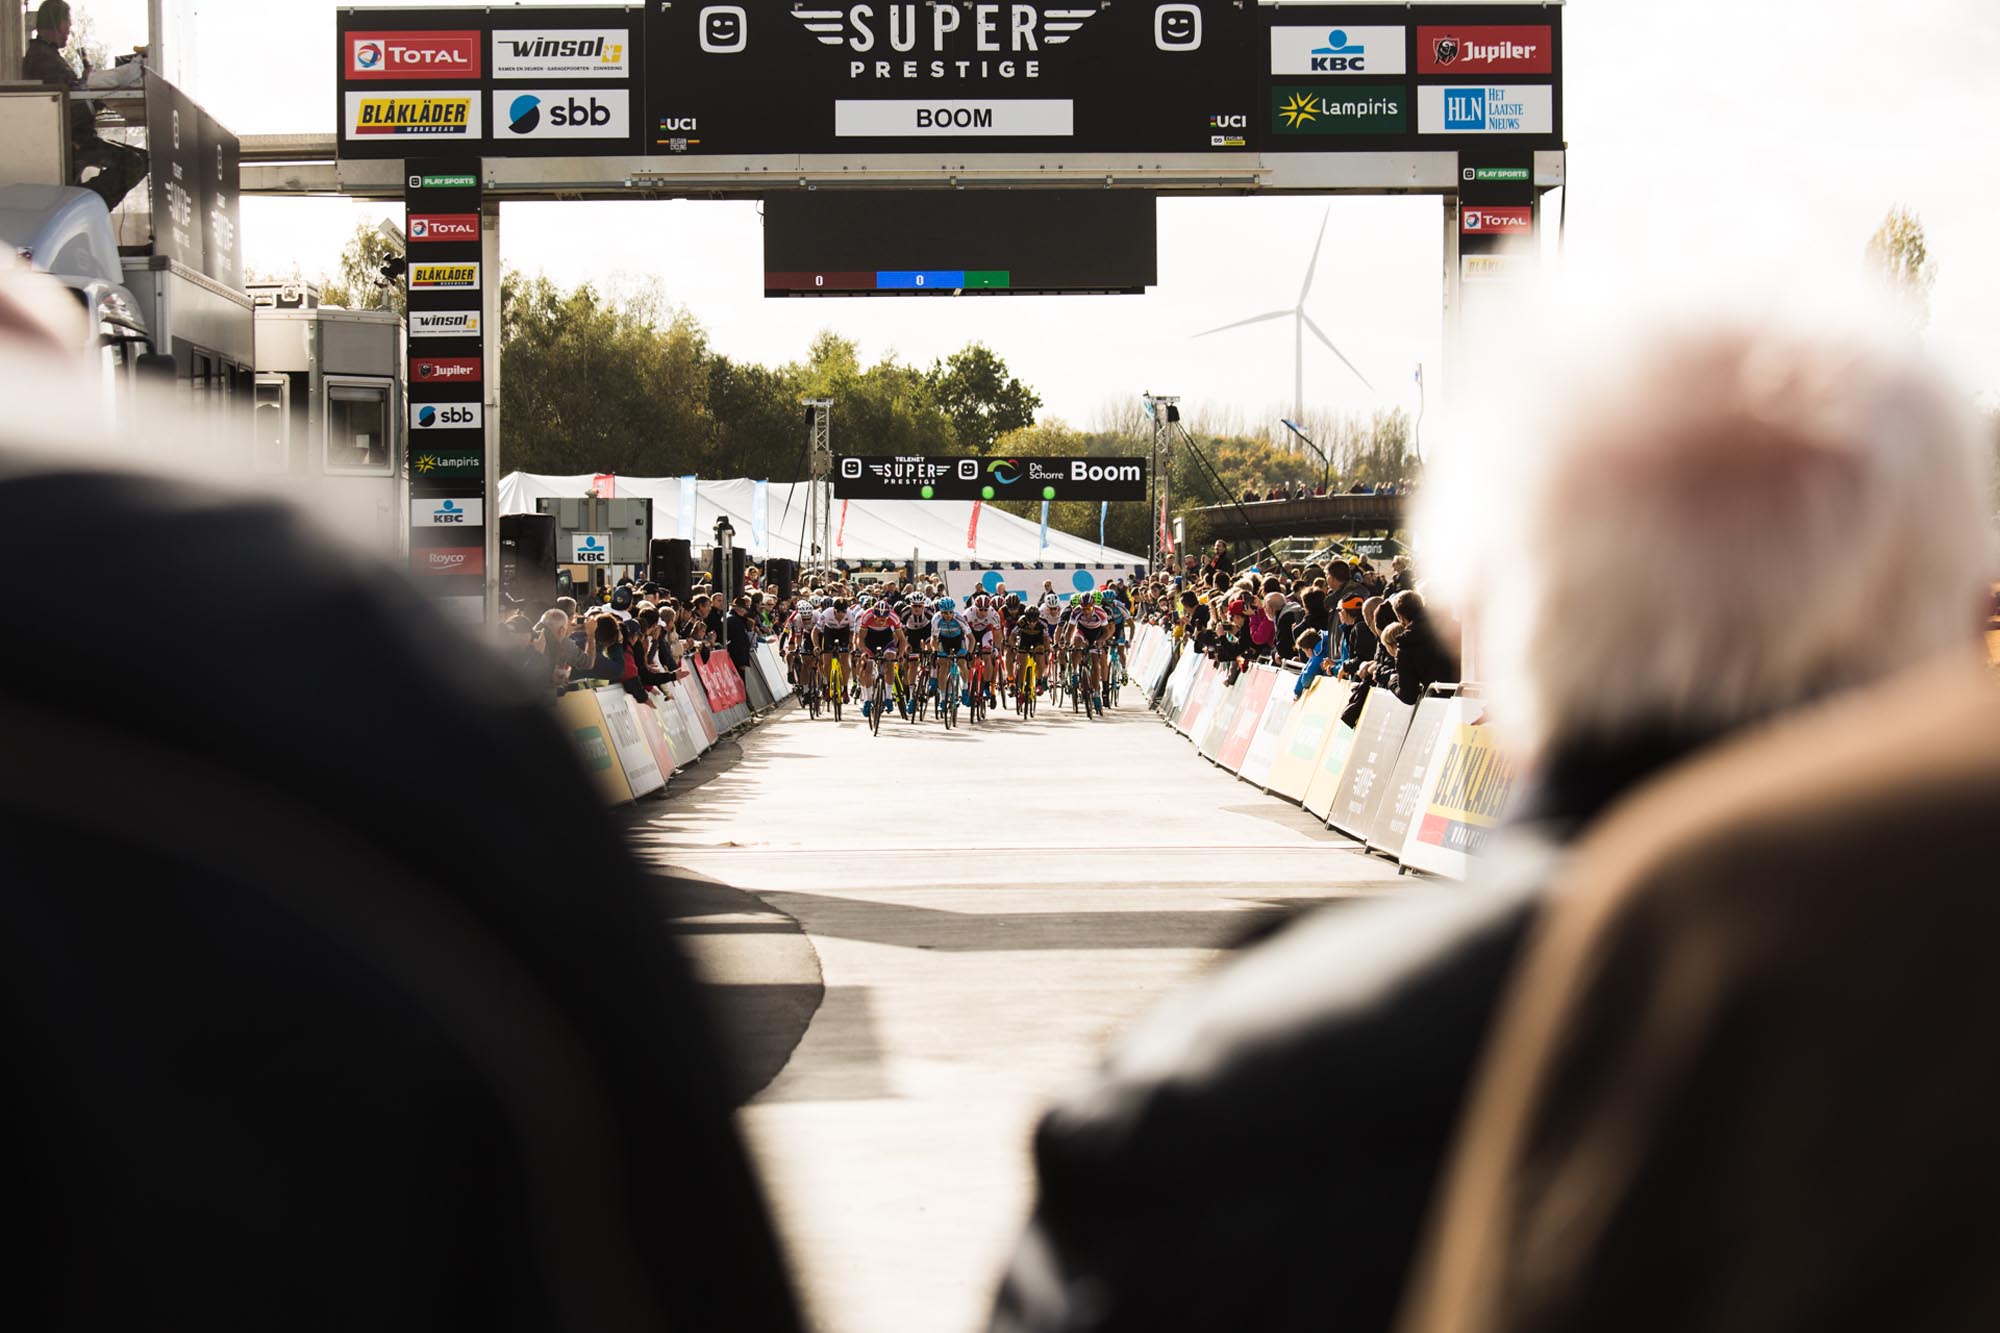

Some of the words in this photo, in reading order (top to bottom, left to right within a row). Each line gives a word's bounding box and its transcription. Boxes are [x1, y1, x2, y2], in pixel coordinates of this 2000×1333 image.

[849, 4, 1039, 52] SUPER
[498, 37, 605, 57] winsol
[1461, 41, 1536, 64] Jupiler
[388, 47, 468, 63] TOTAL
[850, 61, 1040, 78] PRESTIGE
[1311, 57, 1365, 71] KBC
[362, 99, 467, 124] BLÅKLÄDER
[549, 97, 611, 126] sbb
[1448, 97, 1483, 121] HLN
[666, 118, 697, 130] UCI
[916, 108, 993, 128] BOOM
[1216, 115, 1247, 128] UCI
[424, 177, 443, 185] PLAY
[444, 177, 474, 185] SPORTS
[1483, 215, 1527, 226] TOTAL
[430, 223, 475, 233] TOTAL
[416, 266, 474, 281] BLÅKLÄDER
[815, 275, 823, 286] 0
[916, 275, 924, 286] 0
[413, 314, 468, 326] winsol
[434, 365, 473, 377] Jupiler
[441, 407, 474, 424] sbb
[884, 463, 935, 478] SUPER
[1029, 463, 1043, 472] De
[1070, 461, 1141, 481] Boom
[1029, 471, 1064, 480] Schorre
[433, 514, 463, 523] KBC
[429, 553, 465, 565] Royco
[577, 552, 605, 562] KBC
